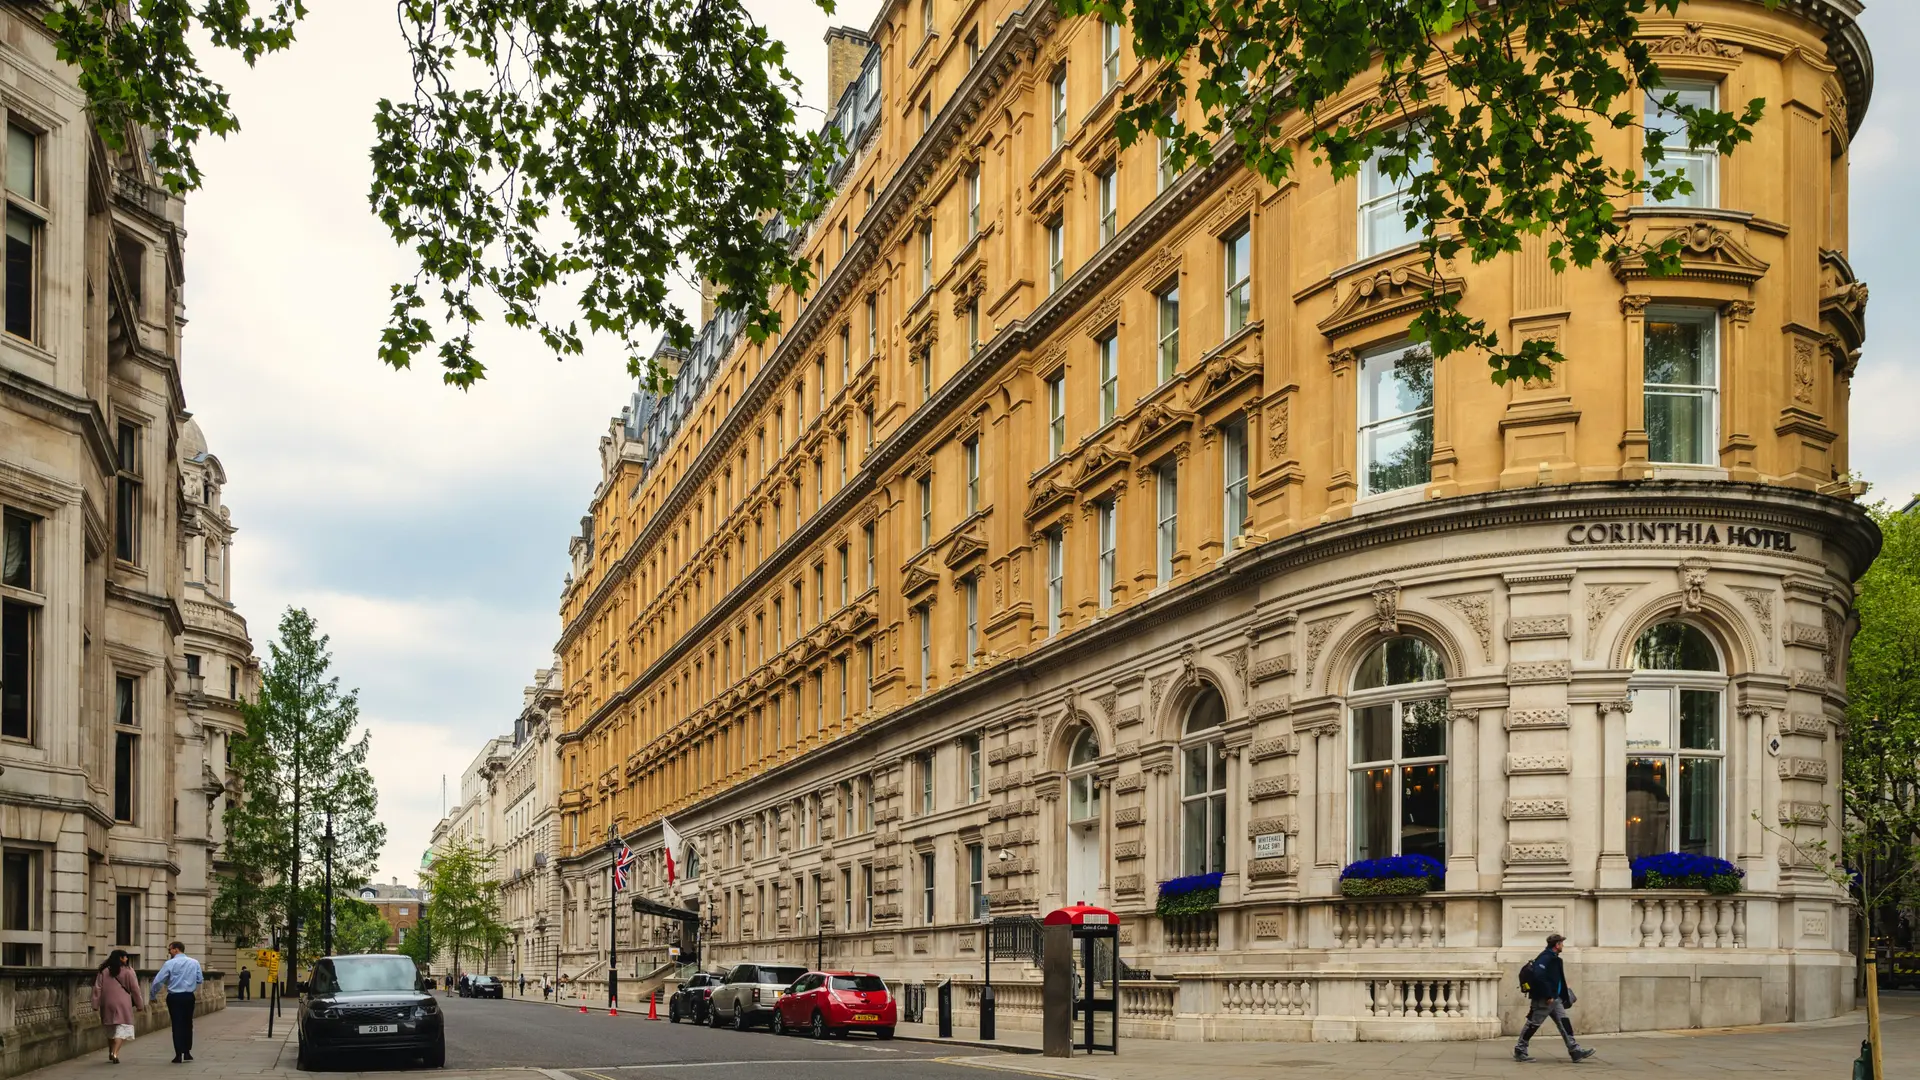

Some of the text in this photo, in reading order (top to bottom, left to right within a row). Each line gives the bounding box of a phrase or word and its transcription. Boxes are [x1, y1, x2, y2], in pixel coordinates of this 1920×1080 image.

[1567, 522, 1797, 552] CORINTHIA HOTEL
[1258, 835, 1281, 843] WHITEHALL
[1258, 843, 1270, 851] PLACE
